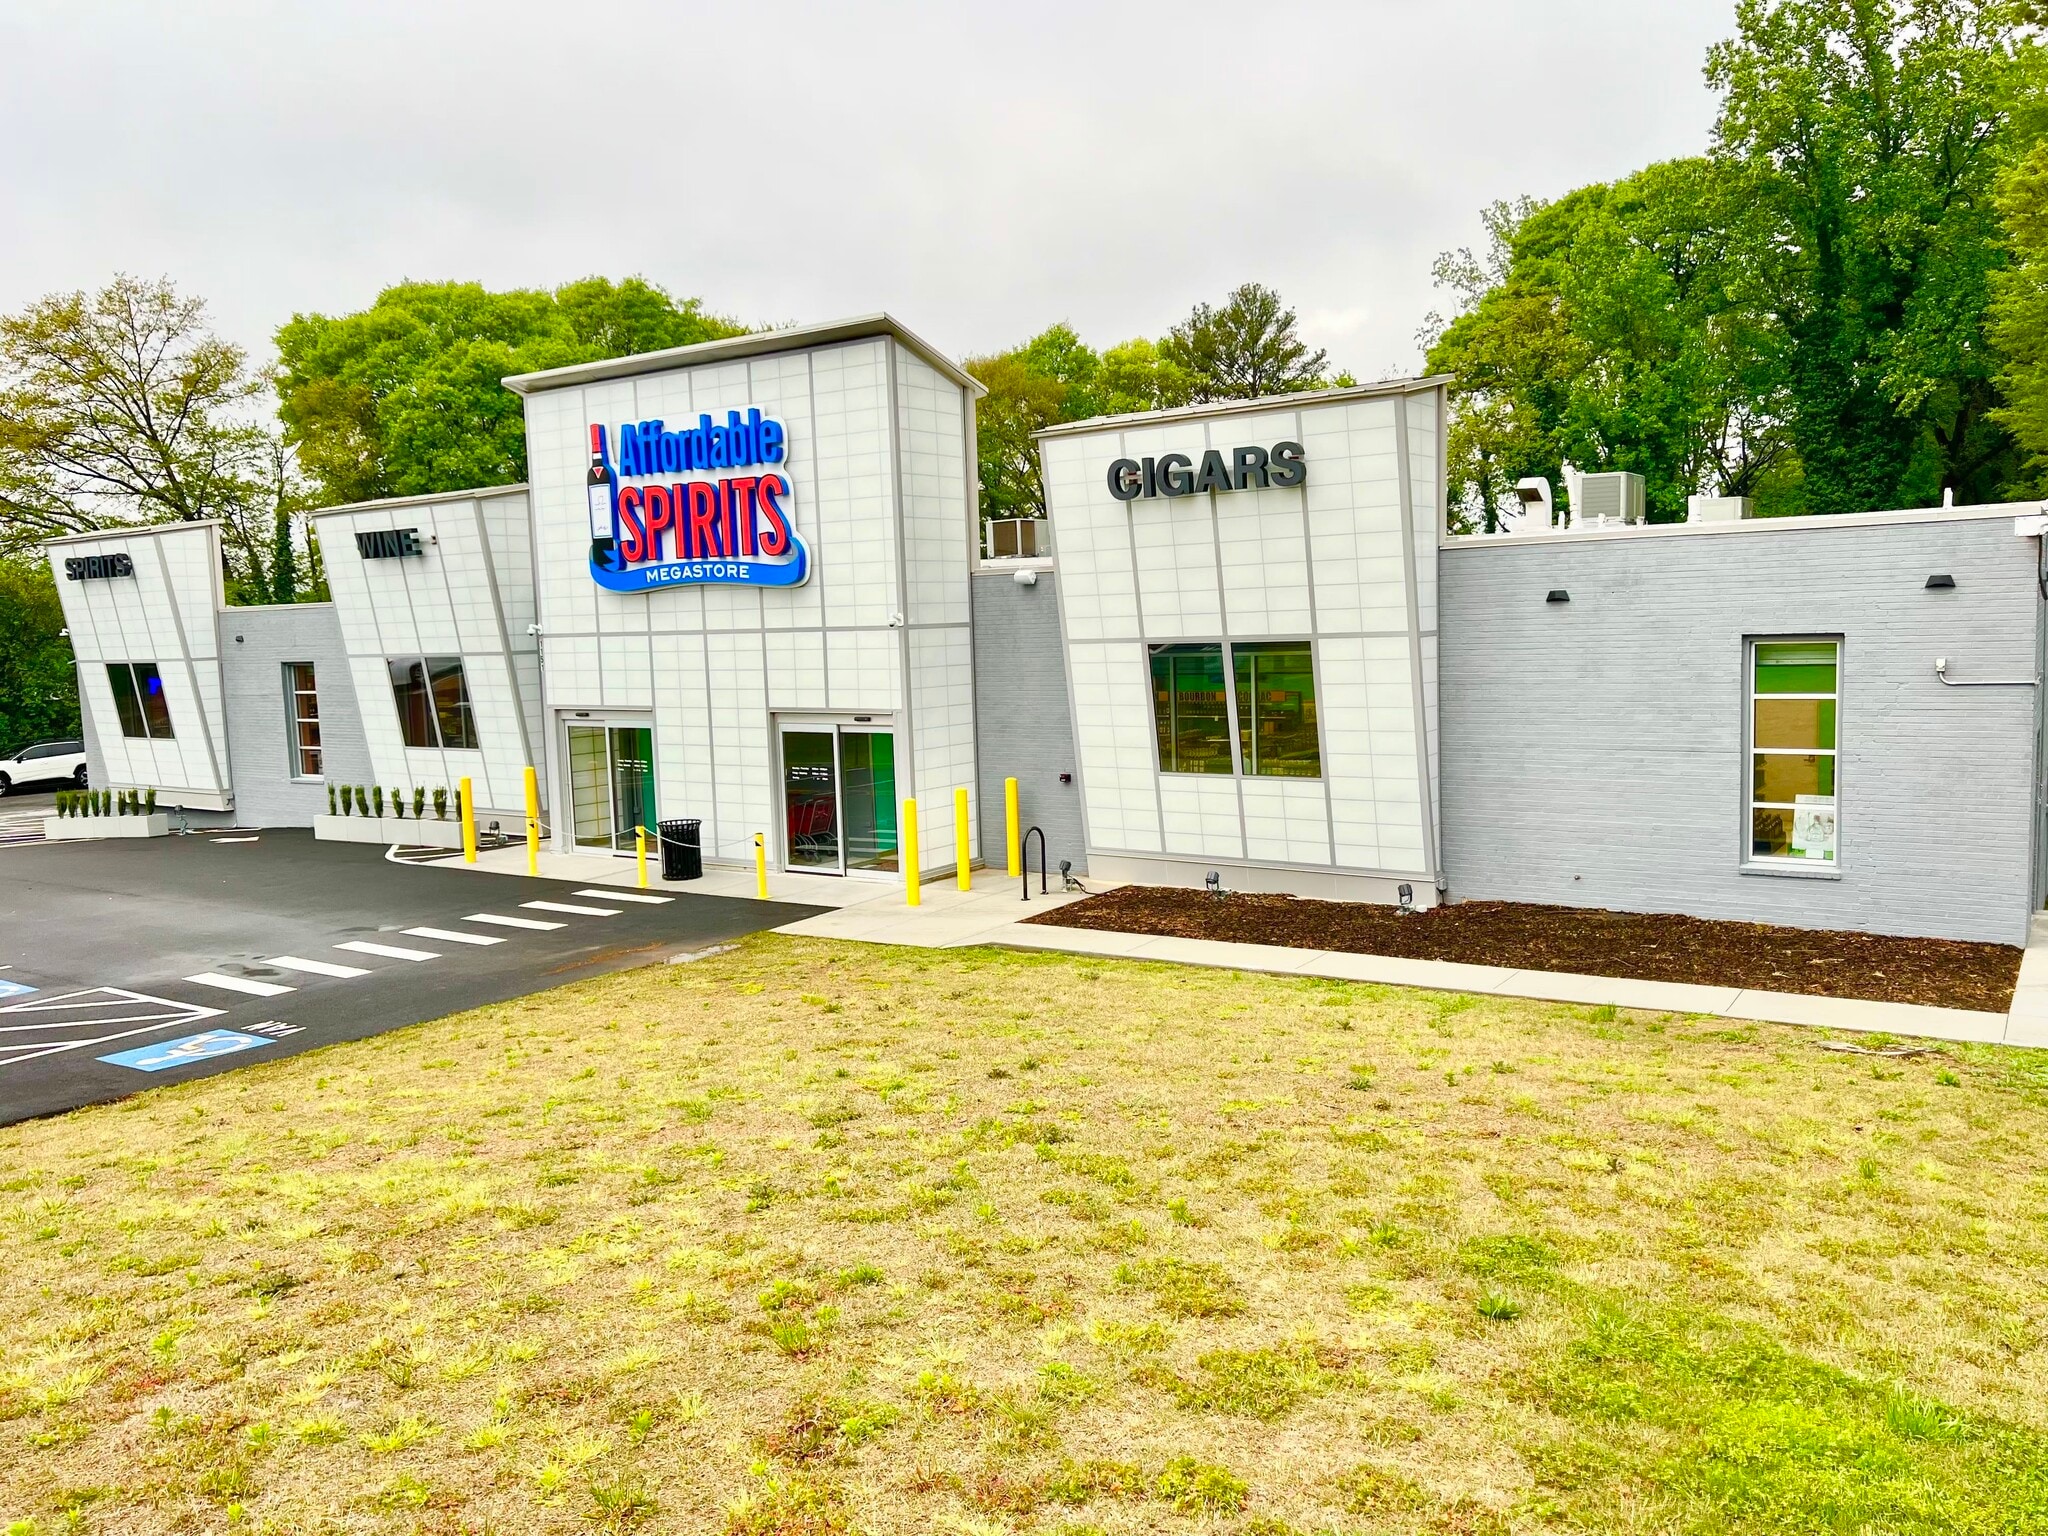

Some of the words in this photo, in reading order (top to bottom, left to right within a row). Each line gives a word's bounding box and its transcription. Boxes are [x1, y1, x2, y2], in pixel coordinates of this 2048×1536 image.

[620, 407, 784, 477] Affordable
[1107, 441, 1307, 501] CIGARS
[618, 473, 790, 563] SPIRITS
[354, 527, 423, 559] WINE
[65, 553, 132, 580] SPIRITS
[646, 563, 750, 583] MEGASTORE
[1178, 691, 1217, 702] BOURBON
[1238, 691, 1272, 702] COAC
[240, 1020, 307, 1038] VAN
